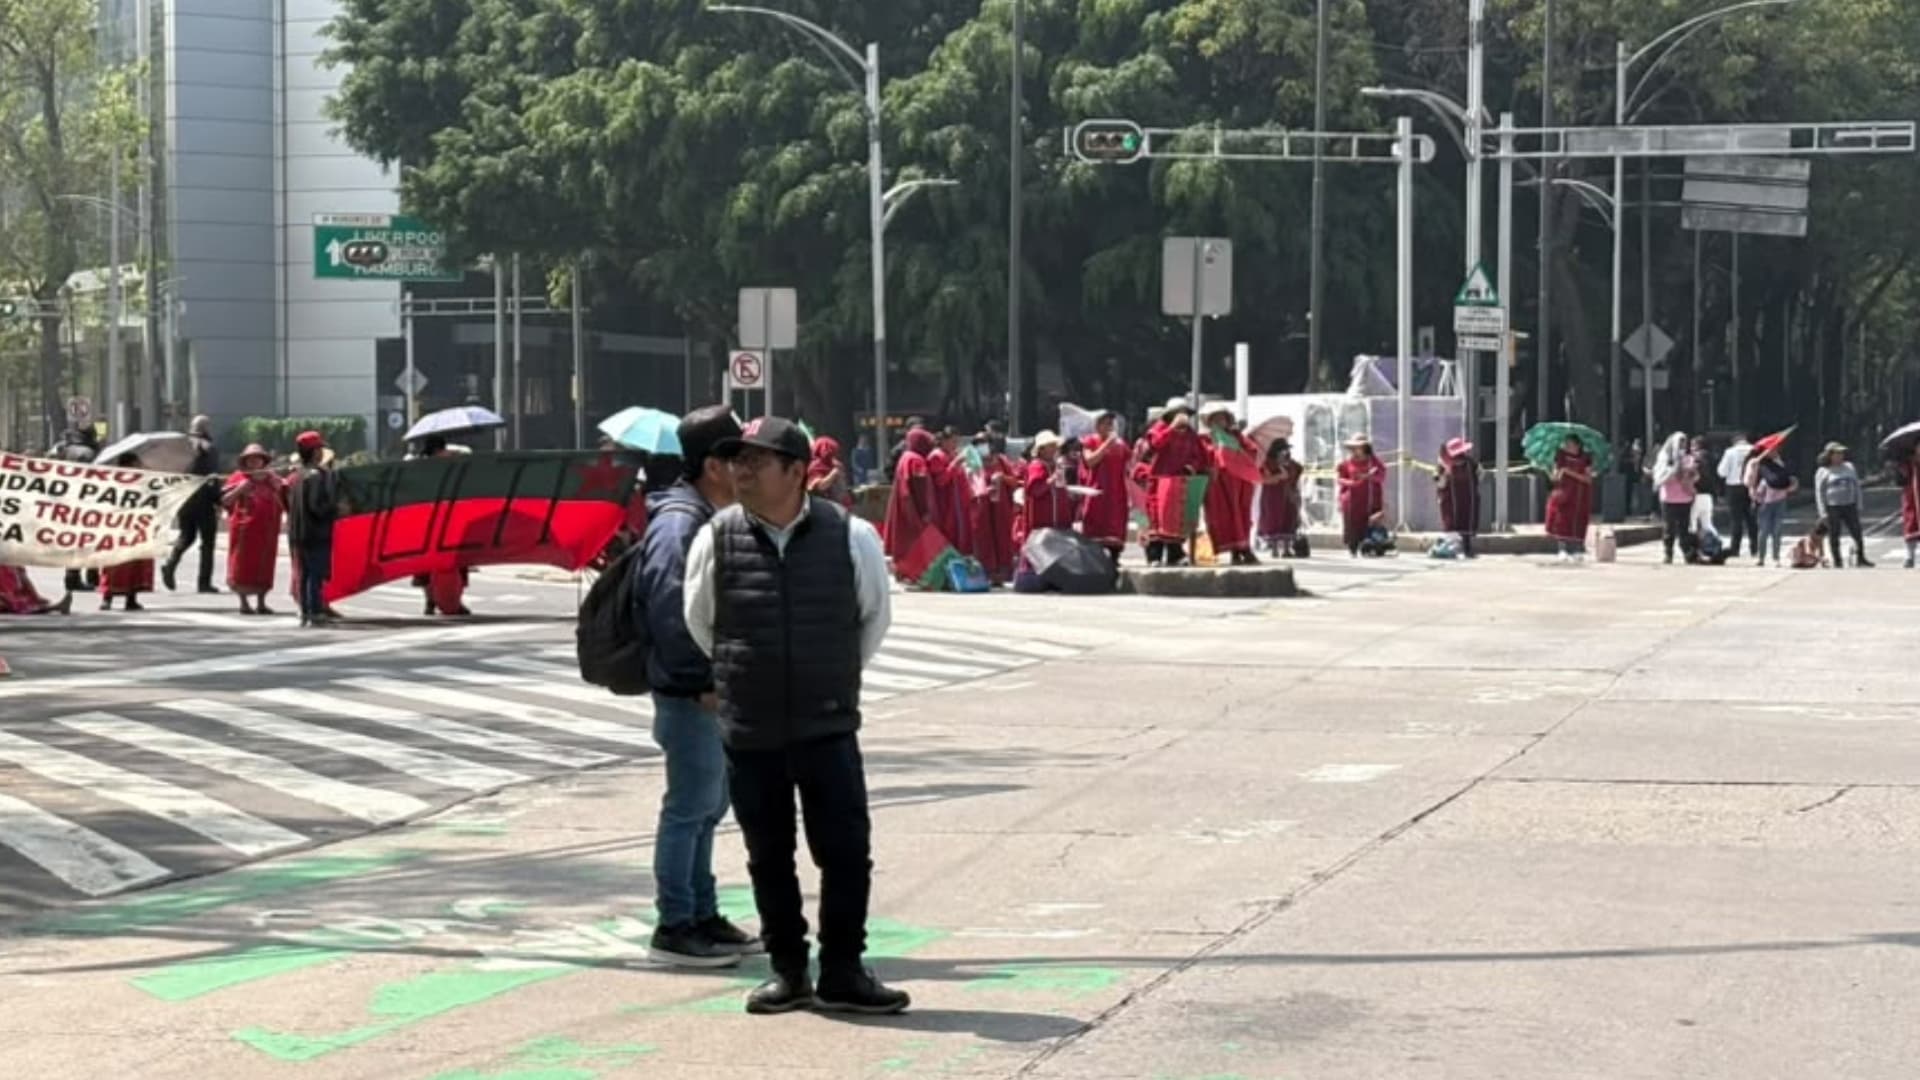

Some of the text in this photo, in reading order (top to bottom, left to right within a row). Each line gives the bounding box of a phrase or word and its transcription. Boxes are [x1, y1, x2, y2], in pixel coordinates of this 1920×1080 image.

[79, 483, 160, 510] PARA
[0, 497, 22, 515] S
[34, 500, 153, 531] TRIQUIS
[0, 521, 24, 543] A
[36, 526, 148, 552] COPALA
